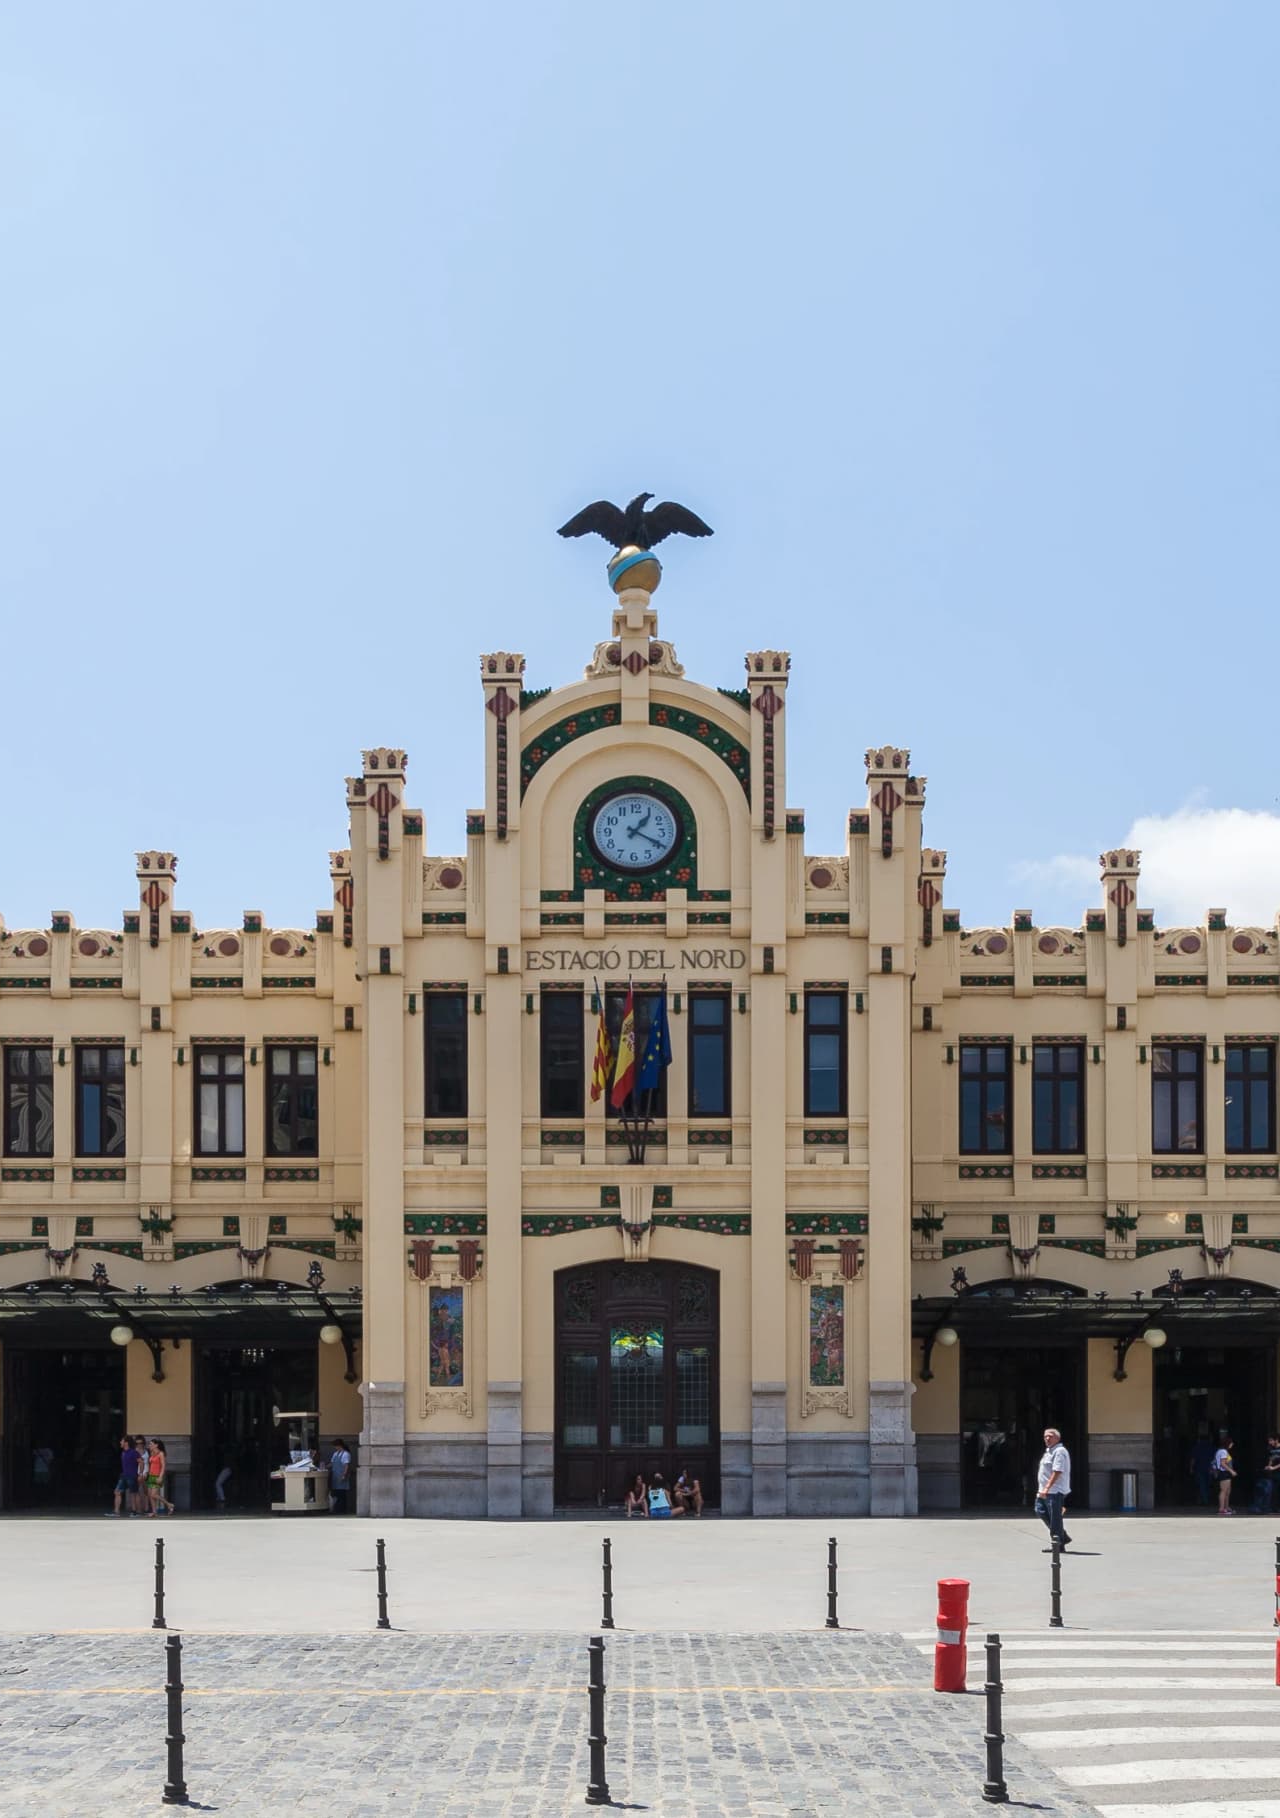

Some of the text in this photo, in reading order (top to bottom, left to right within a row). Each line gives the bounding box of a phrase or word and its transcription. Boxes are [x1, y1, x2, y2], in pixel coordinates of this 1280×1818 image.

[619, 806, 626, 817] 11
[630, 803, 642, 814] 12
[607, 816, 618, 826] 10
[655, 815, 663, 826] 2
[604, 827, 612, 837] 9
[658, 828, 666, 838] 3
[606, 839, 615, 849] 8
[617, 849, 624, 859] 7
[630, 852, 638, 861] 6
[644, 850, 652, 859] 5
[525, 944, 746, 971] ESTACIÓ DEL NORD
